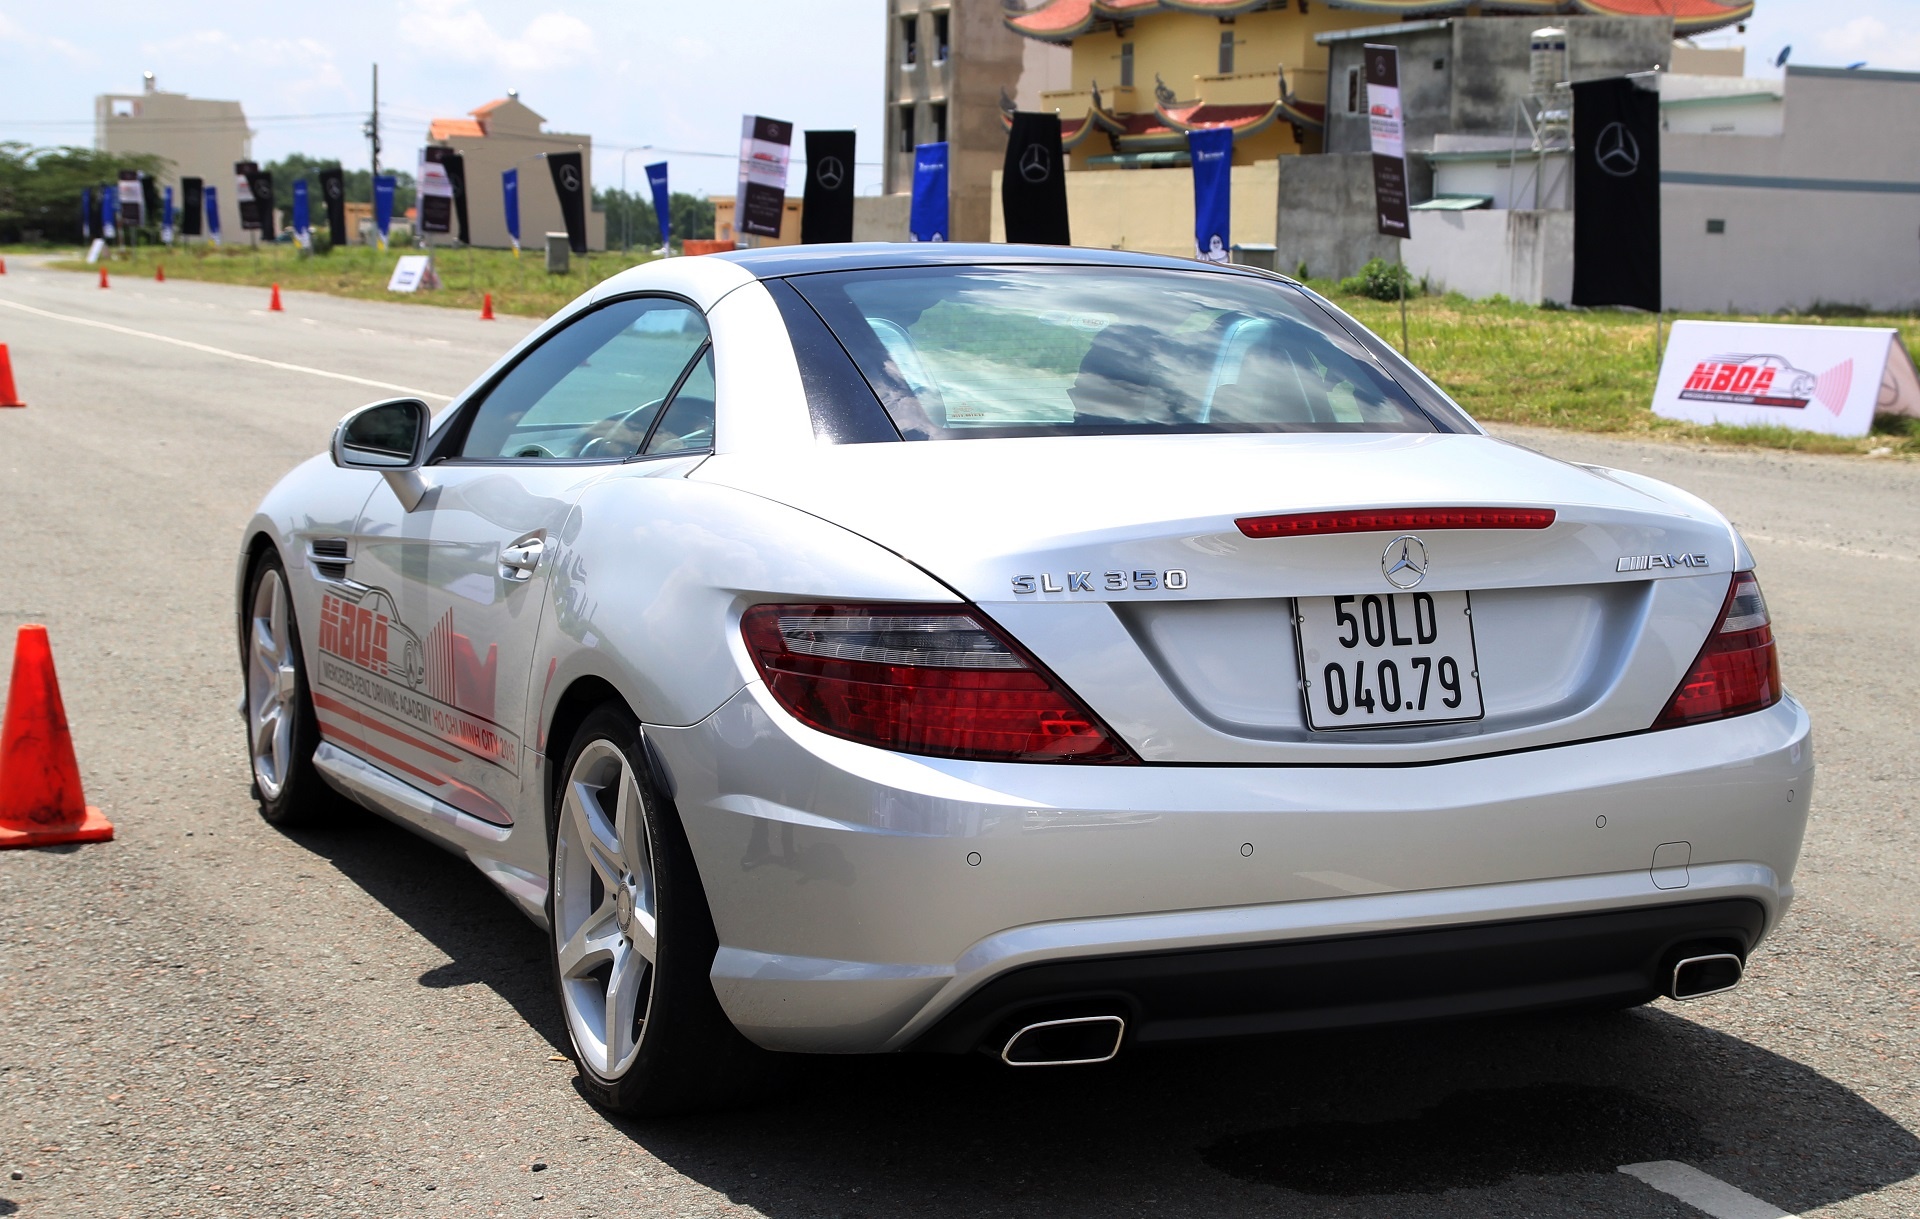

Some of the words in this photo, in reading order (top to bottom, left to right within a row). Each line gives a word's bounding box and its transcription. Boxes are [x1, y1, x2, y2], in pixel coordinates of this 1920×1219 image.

[1684, 362, 1777, 396] MBDA
[1011, 571, 1095, 594] SLK
[1104, 569, 1188, 591] 350
[1647, 553, 1709, 570] AMG
[319, 594, 388, 676] MBDA
[1333, 592, 1437, 648] 50LD
[323, 660, 372, 699] MERCEDES-BENZ
[372, 681, 399, 711] DRIVING
[400, 694, 432, 726] ACADEMY
[432, 708, 445, 731] HO
[445, 714, 459, 737] CHI
[459, 720, 481, 748] MINH
[481, 729, 499, 755] CITY
[499, 738, 516, 765] 2015
[1324, 656, 1461, 715] 040.79
